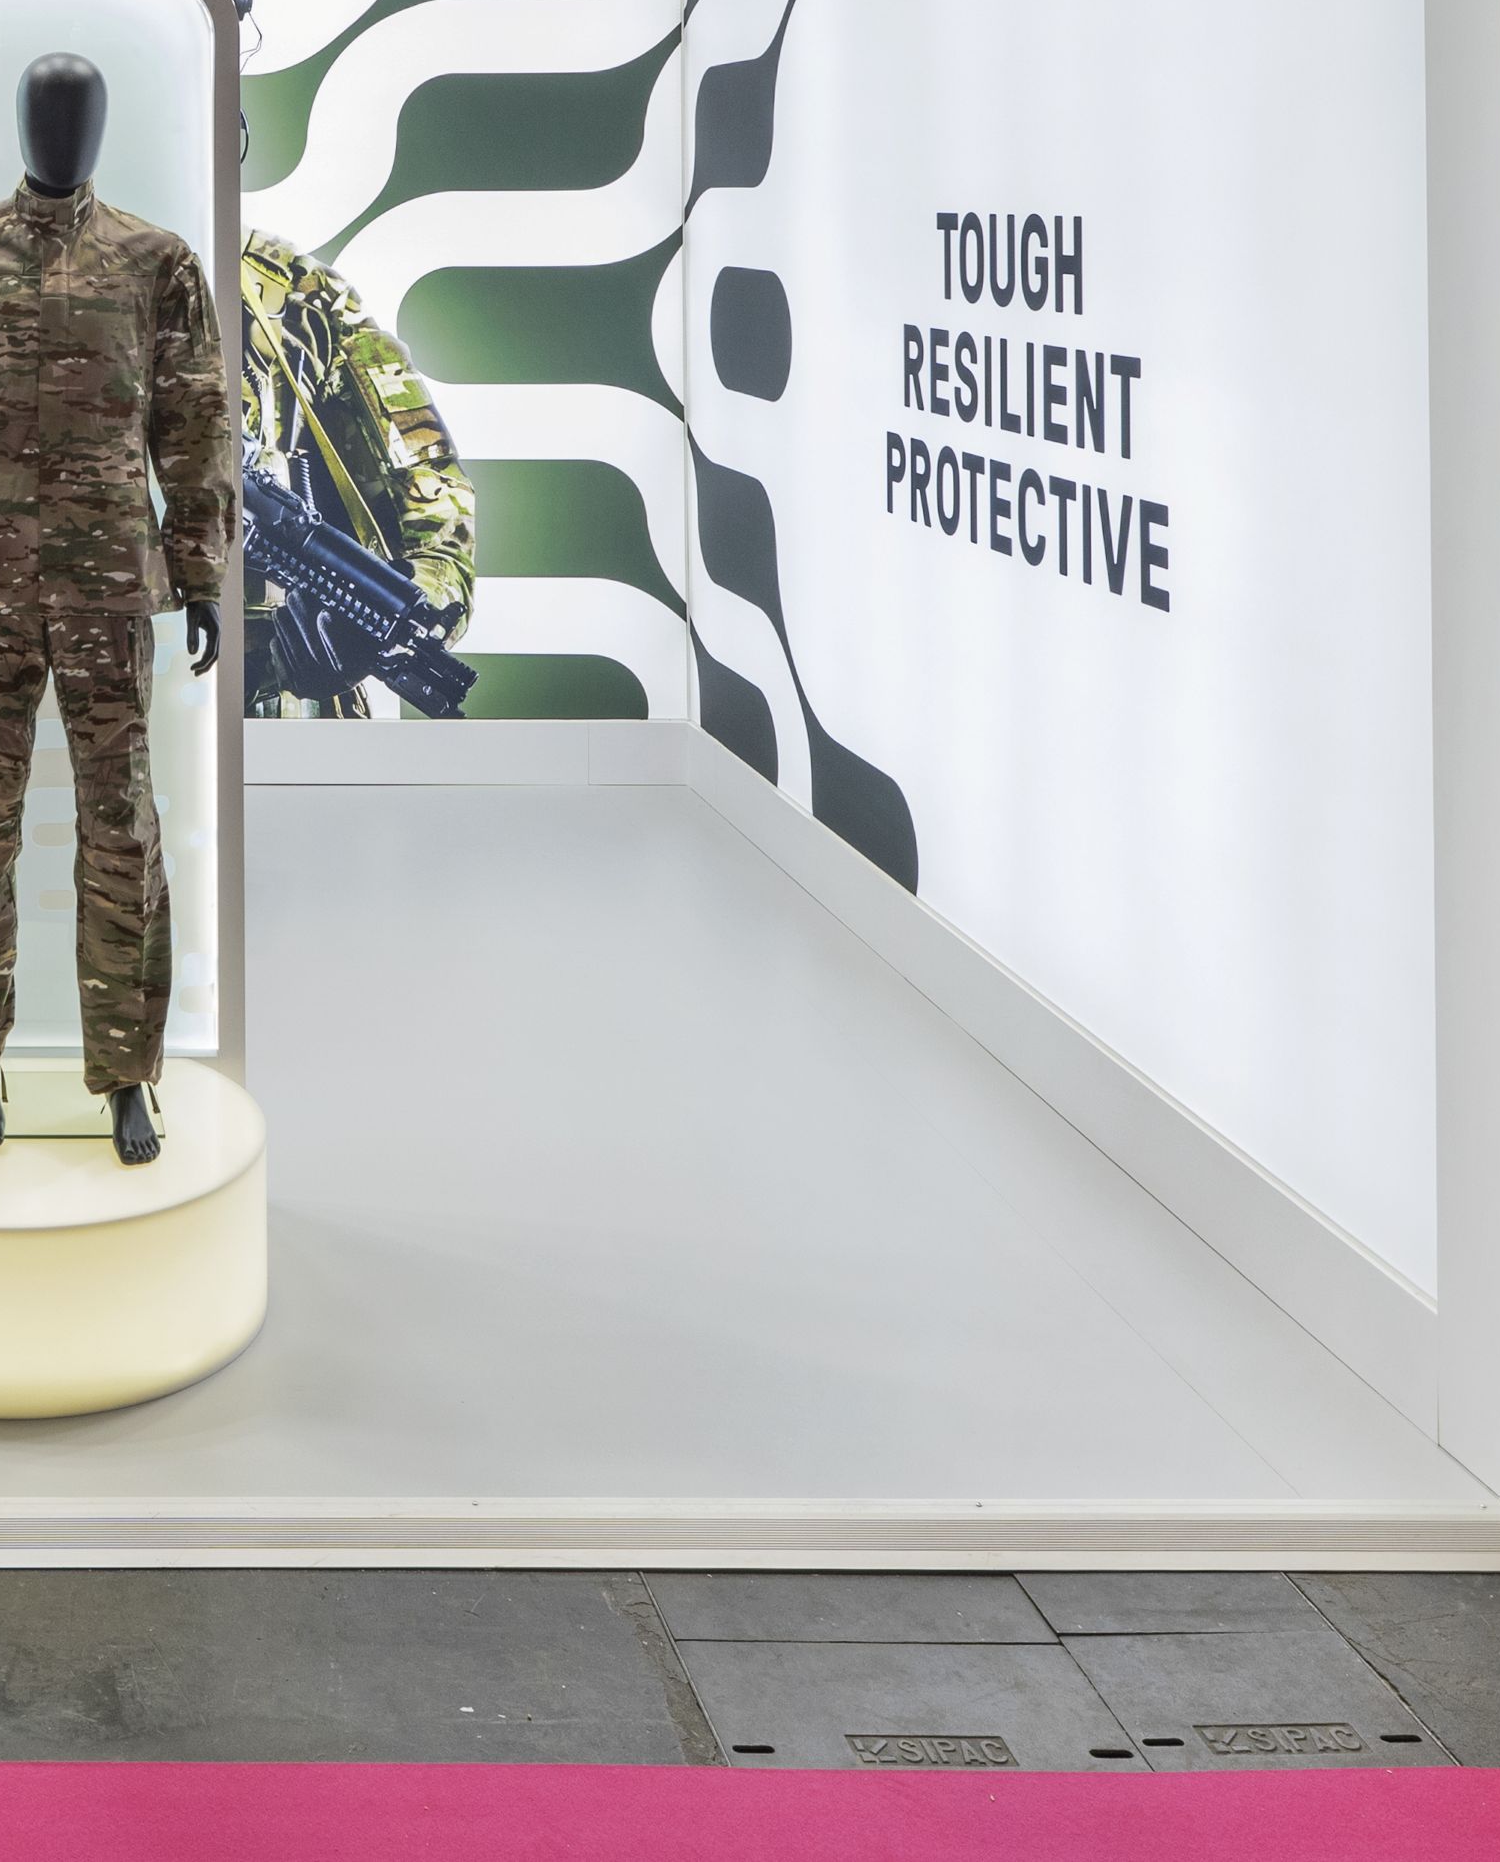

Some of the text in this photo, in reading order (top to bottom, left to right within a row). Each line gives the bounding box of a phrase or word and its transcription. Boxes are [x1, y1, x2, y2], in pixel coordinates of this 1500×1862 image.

[936, 212, 1083, 315] TOUGH
[903, 323, 1142, 460] RESILIENT
[886, 431, 1170, 613] PROTECTIVE
[899, 1739, 1010, 1765] SIPAC
[1247, 1728, 1362, 1753] SIPAC
